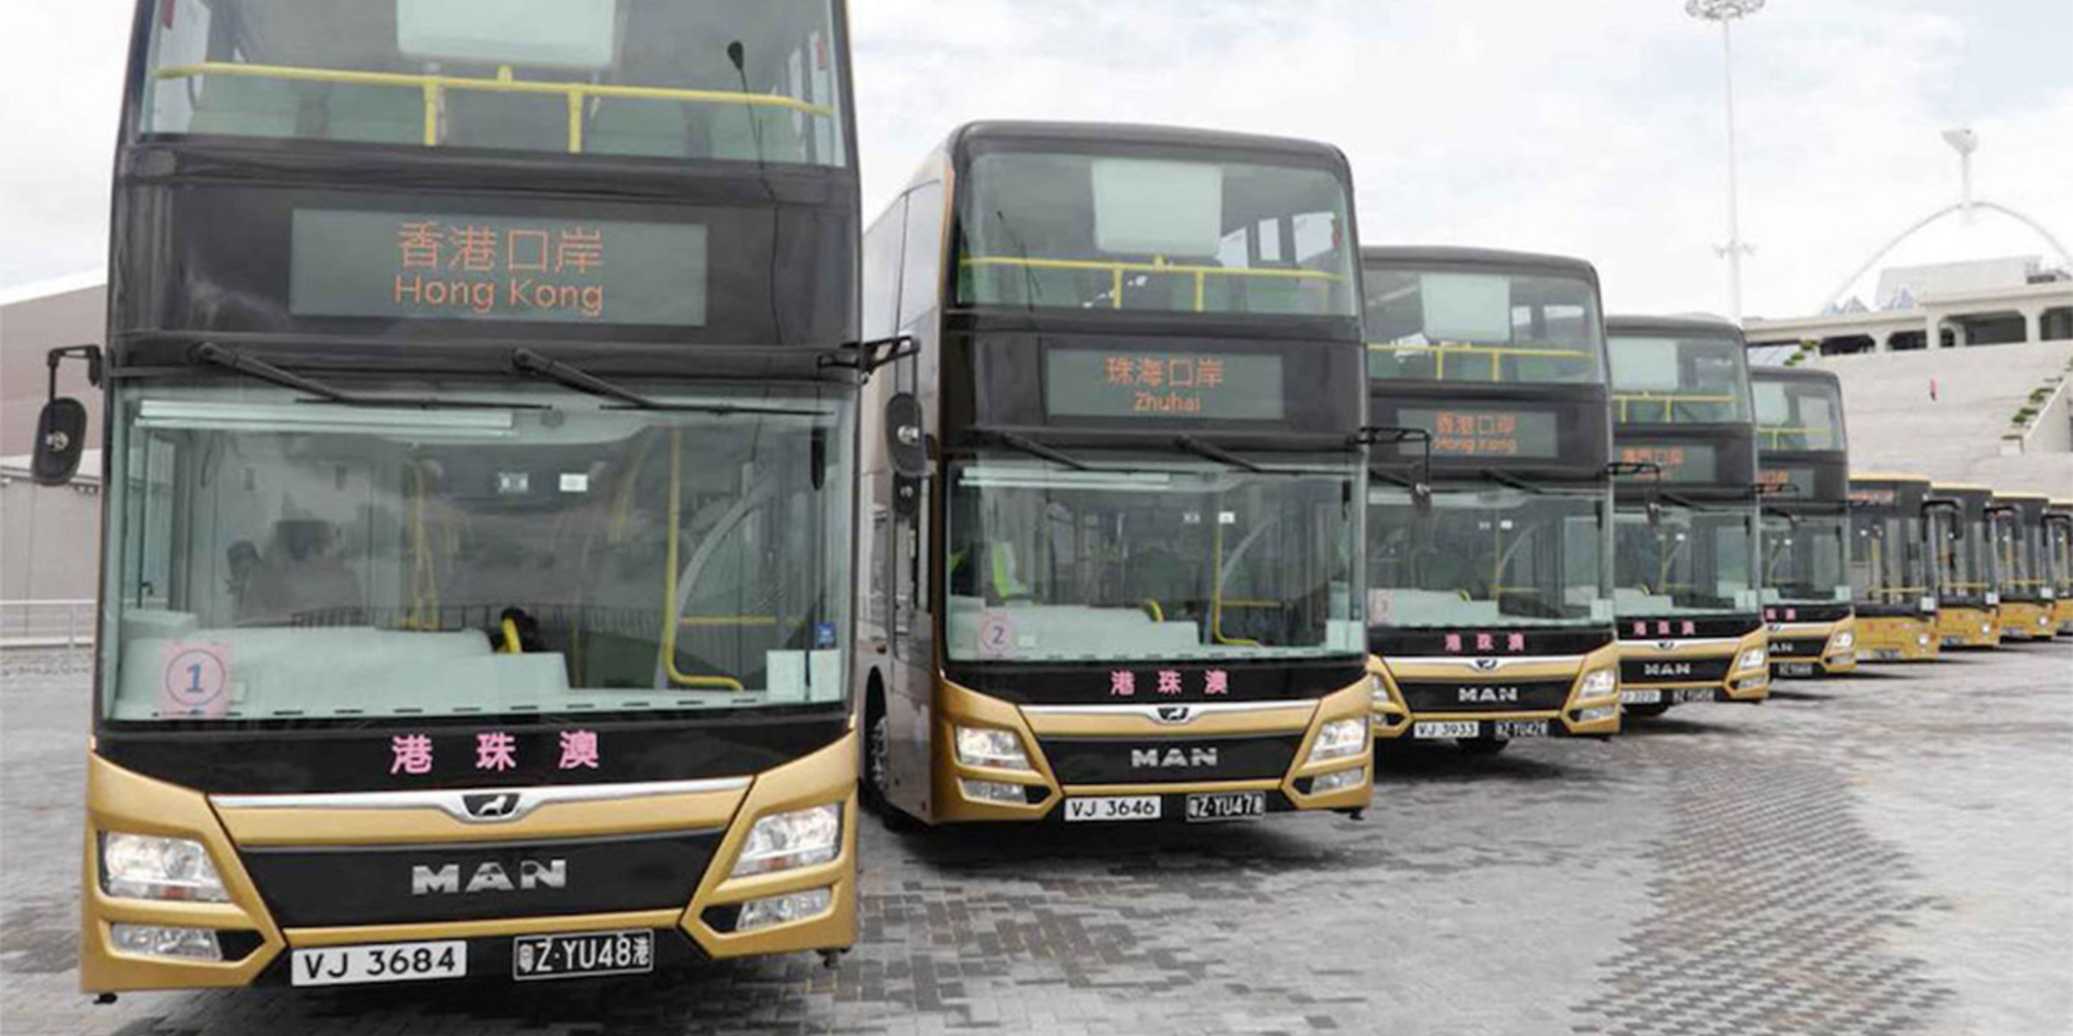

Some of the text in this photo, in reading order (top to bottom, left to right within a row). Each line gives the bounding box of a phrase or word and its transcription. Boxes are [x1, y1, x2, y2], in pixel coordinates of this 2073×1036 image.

[397, 221, 603, 274] 香港口岸
[395, 275, 604, 316] Hong Kong
[1105, 355, 1224, 388] 珠海口岸
[1135, 390, 1201, 413] Zhuhai
[992, 625, 1005, 645] 2
[186, 663, 205, 693] 1
[1458, 687, 1518, 702] MAN
[390, 730, 600, 775] 港珠澳
[1131, 747, 1218, 768] MAN
[1071, 799, 1156, 817] VJ 3646
[411, 858, 567, 896] MAN
[304, 947, 456, 979] VJ 3684
